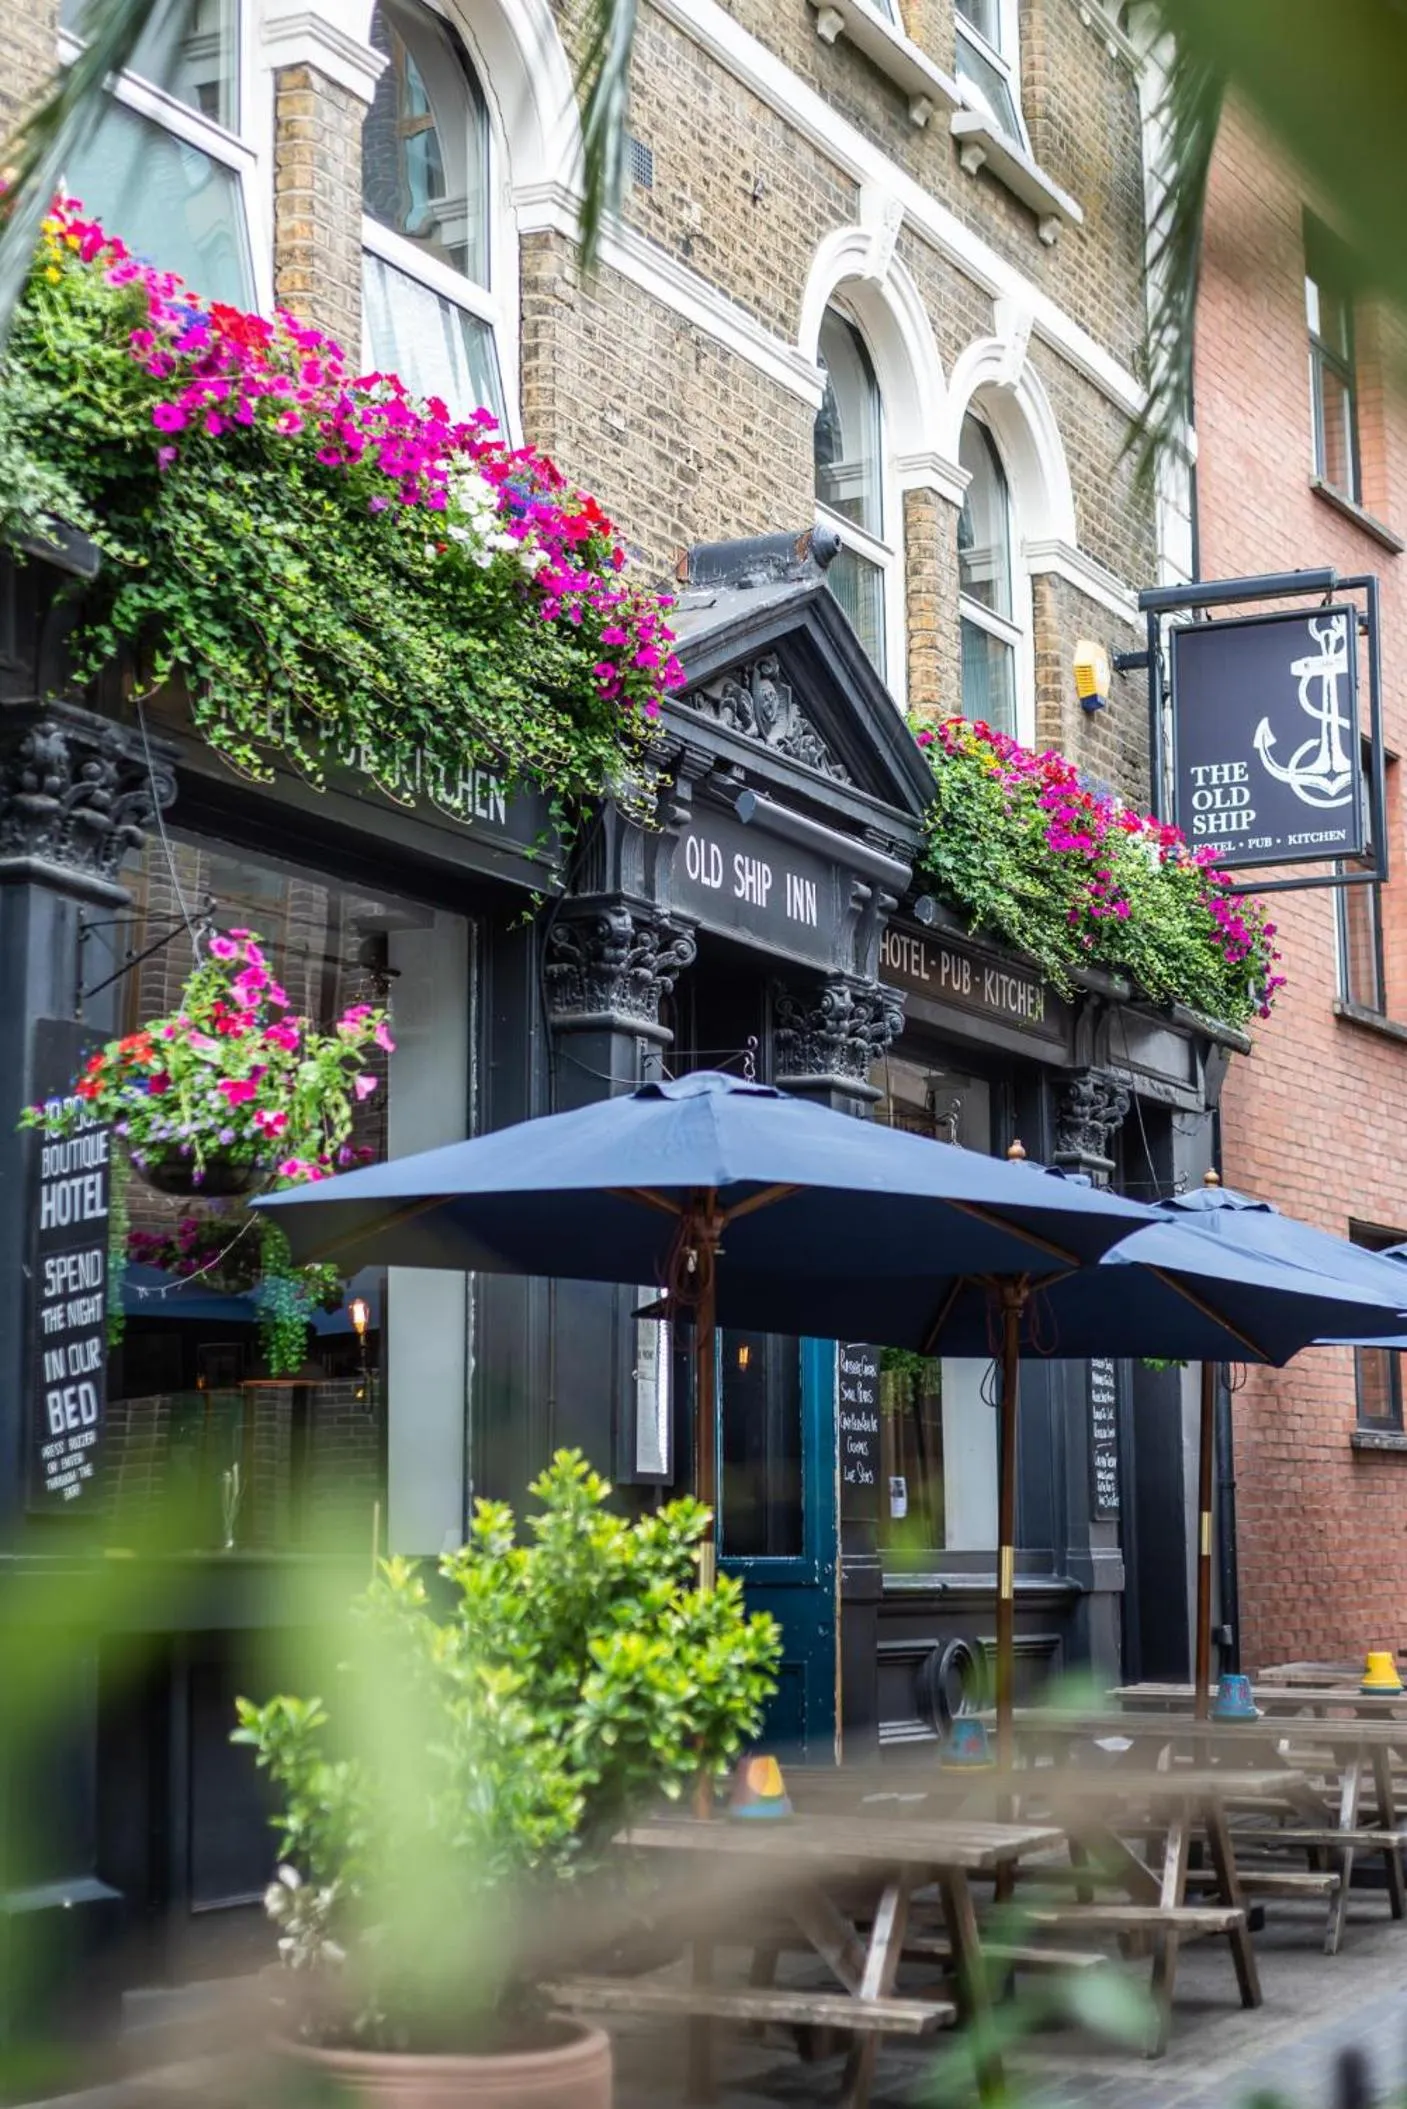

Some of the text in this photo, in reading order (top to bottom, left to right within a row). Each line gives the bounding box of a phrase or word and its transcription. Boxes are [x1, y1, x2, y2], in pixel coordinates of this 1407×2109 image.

[1191, 761, 1248, 787] THE
[1192, 786, 1251, 811] OLD
[1192, 809, 1256, 836] SHIP
[1248, 837, 1273, 850] PUB
[1288, 829, 1346, 846] KITCHEN
[686, 835, 817, 927] OLD SHIP INN
[941, 951, 971, 995] PUB
[42, 1130, 108, 1179] BOUTIQUE
[40, 1172, 108, 1230] HOTEL
[44, 1249, 103, 1297] SPEND
[42, 1292, 103, 1334] THE NIGHT
[44, 1336, 101, 1382] IN OUR
[47, 1382, 97, 1435] BED
